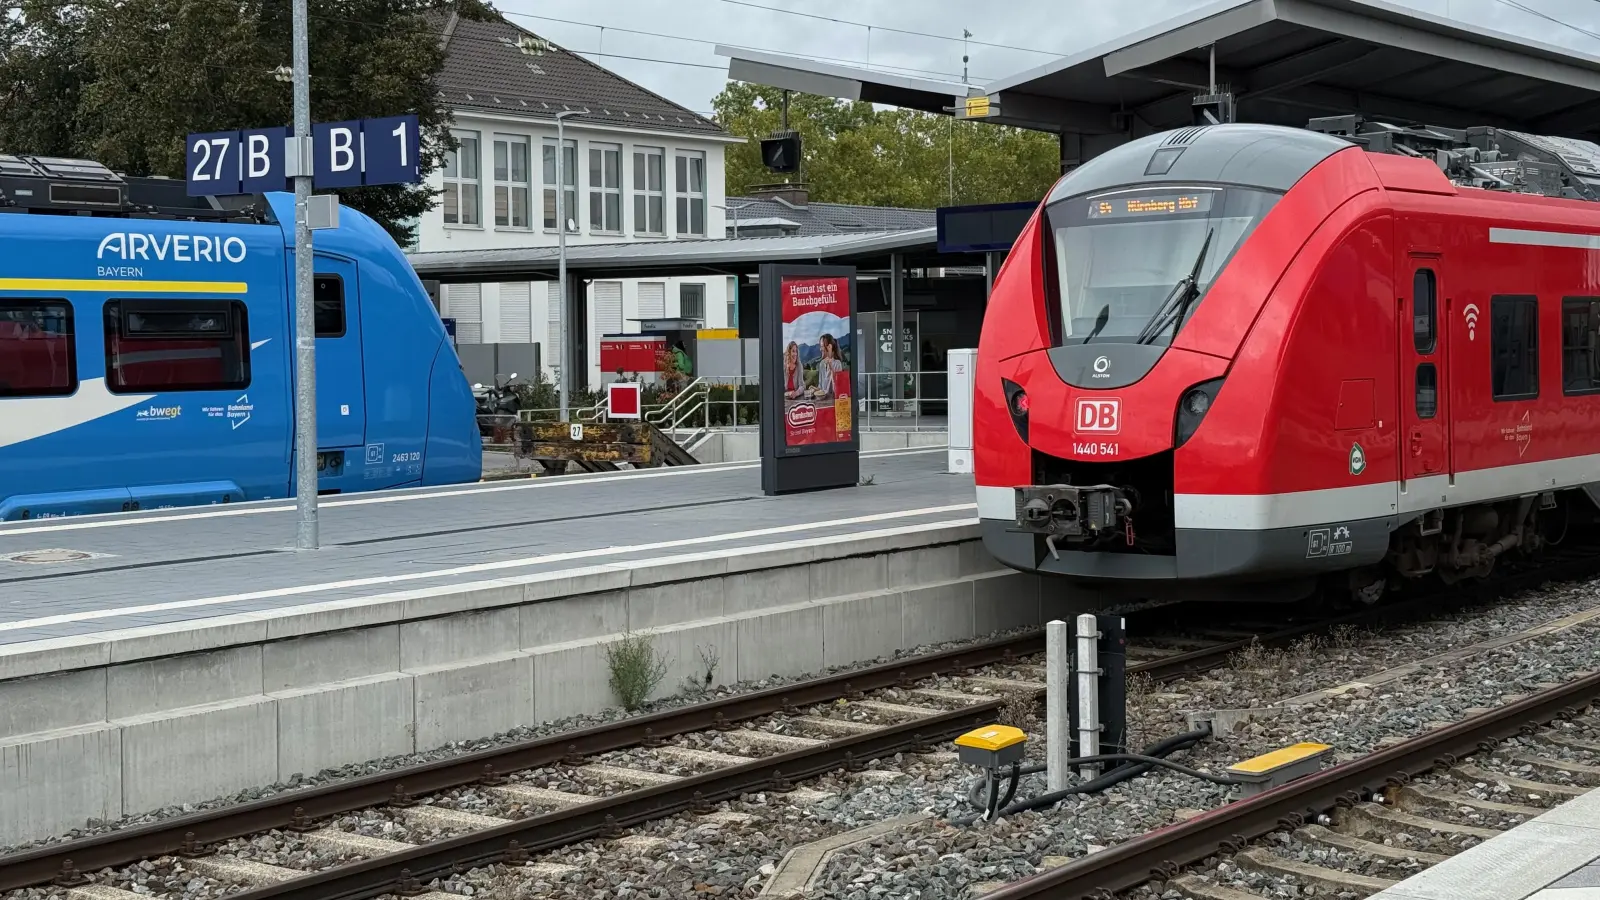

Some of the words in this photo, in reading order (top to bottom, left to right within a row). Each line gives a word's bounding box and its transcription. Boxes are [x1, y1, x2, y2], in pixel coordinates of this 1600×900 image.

[330, 127, 355, 173] B
[392, 121, 408, 167] 1
[192, 138, 230, 181] 27
[249, 135, 270, 178] B
[1127, 199, 1175, 212] Nürnberg
[1178, 196, 1198, 209] Hbf
[97, 232, 247, 263] ARVERIO
[97, 266, 143, 277] BAYERN
[790, 284, 815, 295] Heimat
[816, 283, 826, 293] ist
[827, 282, 838, 292] ein
[792, 293, 837, 307] Bauchgefühl.
[149, 405, 182, 418] bwegt
[1079, 403, 1115, 428] DB
[572, 426, 581, 437] 27
[1072, 442, 1097, 455] 1440
[1100, 442, 1119, 455] 541
[392, 452, 409, 463] 2463
[410, 451, 420, 461] 120
